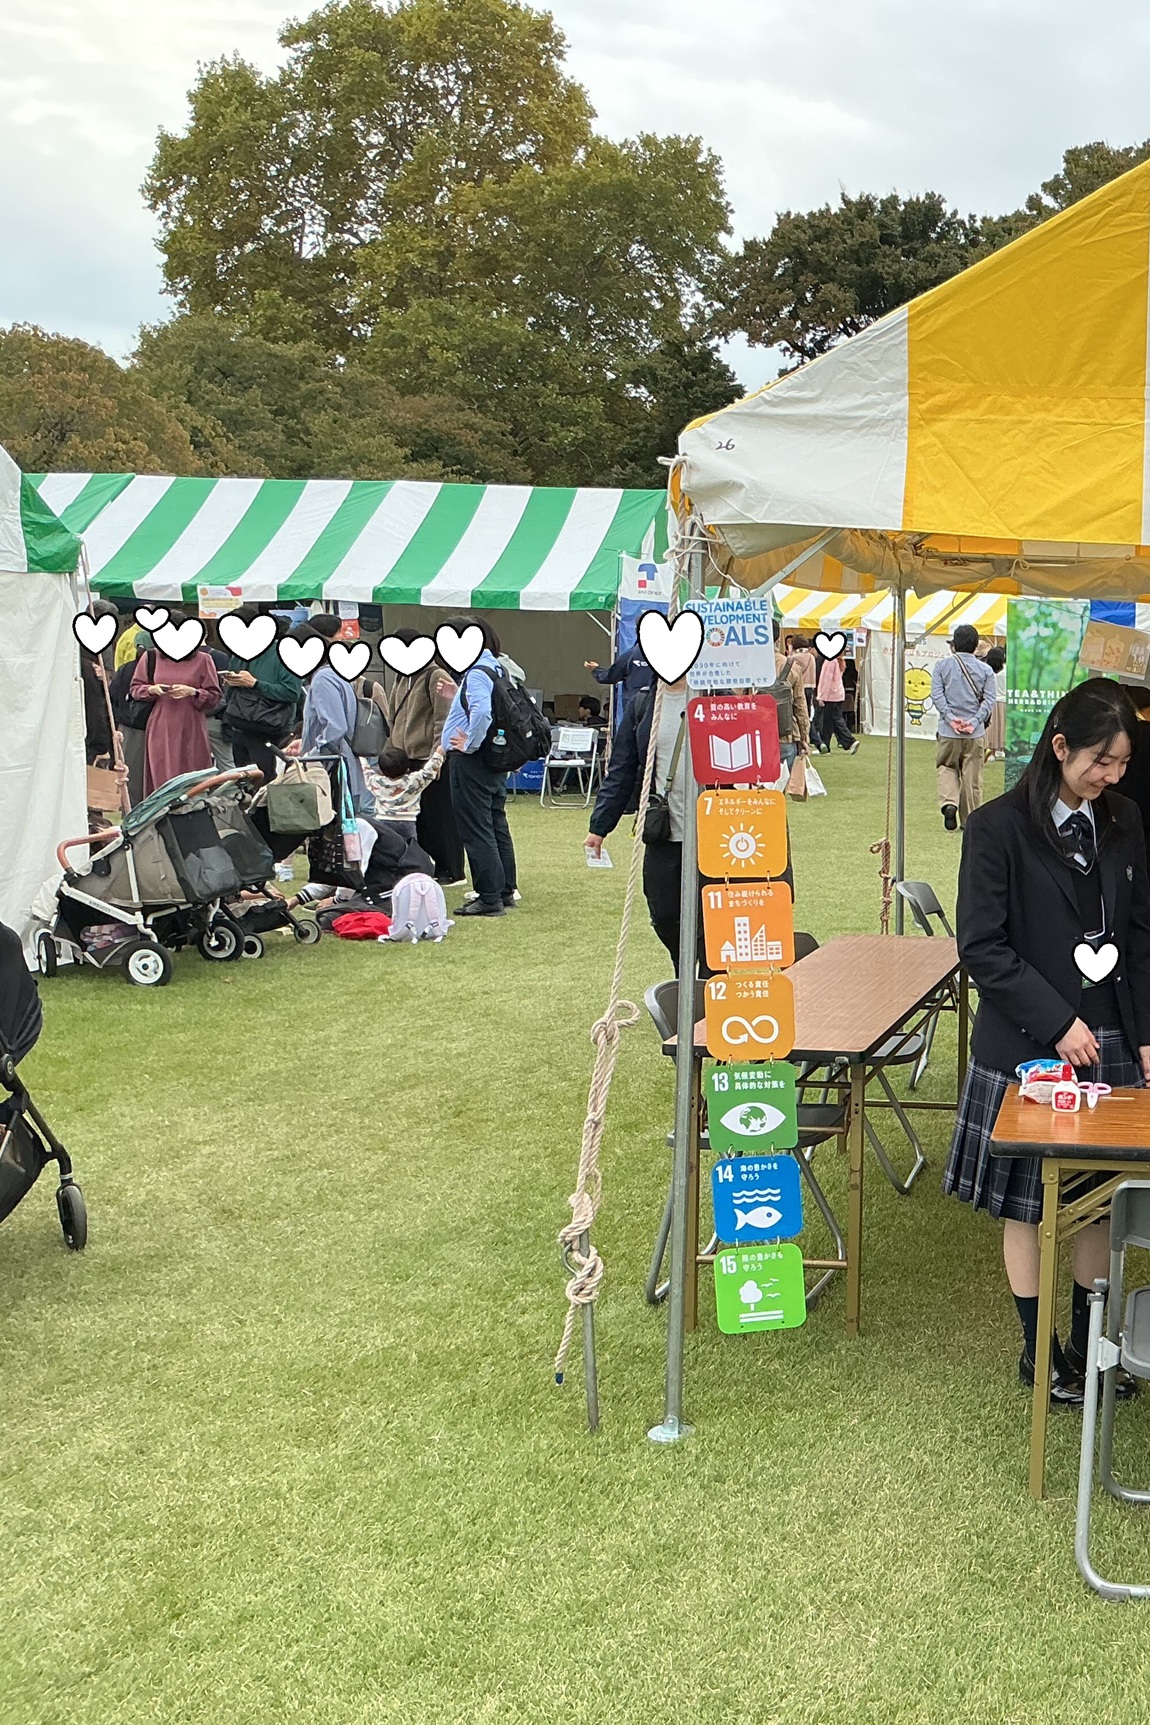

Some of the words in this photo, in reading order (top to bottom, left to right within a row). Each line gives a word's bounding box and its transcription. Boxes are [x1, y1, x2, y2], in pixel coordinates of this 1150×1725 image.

[715, 438, 735, 451] 26
[685, 600, 768, 613] SUSTAINABLE
[702, 613, 767, 625] VELOPMENT
[710, 702, 757, 712] 質の高い教育を
[694, 704, 705, 723] 4
[711, 712, 738, 721] みんなに
[703, 797, 713, 816] 7
[718, 797, 776, 806] エネルギーをみんなに
[718, 807, 763, 816] そしてクリーンに
[707, 891, 723, 909] 11
[729, 899, 765, 908] まちづくりを
[736, 980, 769, 989] つくる責任
[708, 982, 727, 1000] 12
[736, 990, 769, 999] つかう責任
[734, 1070, 772, 1080] 気候変動に
[712, 1072, 729, 1092] 13
[735, 1080, 785, 1091] 具体的な対策を
[716, 1164, 734, 1183] 14
[741, 1172, 760, 1181] 守ろう
[720, 1255, 737, 1275] 15
[743, 1263, 762, 1272] 守ろう
